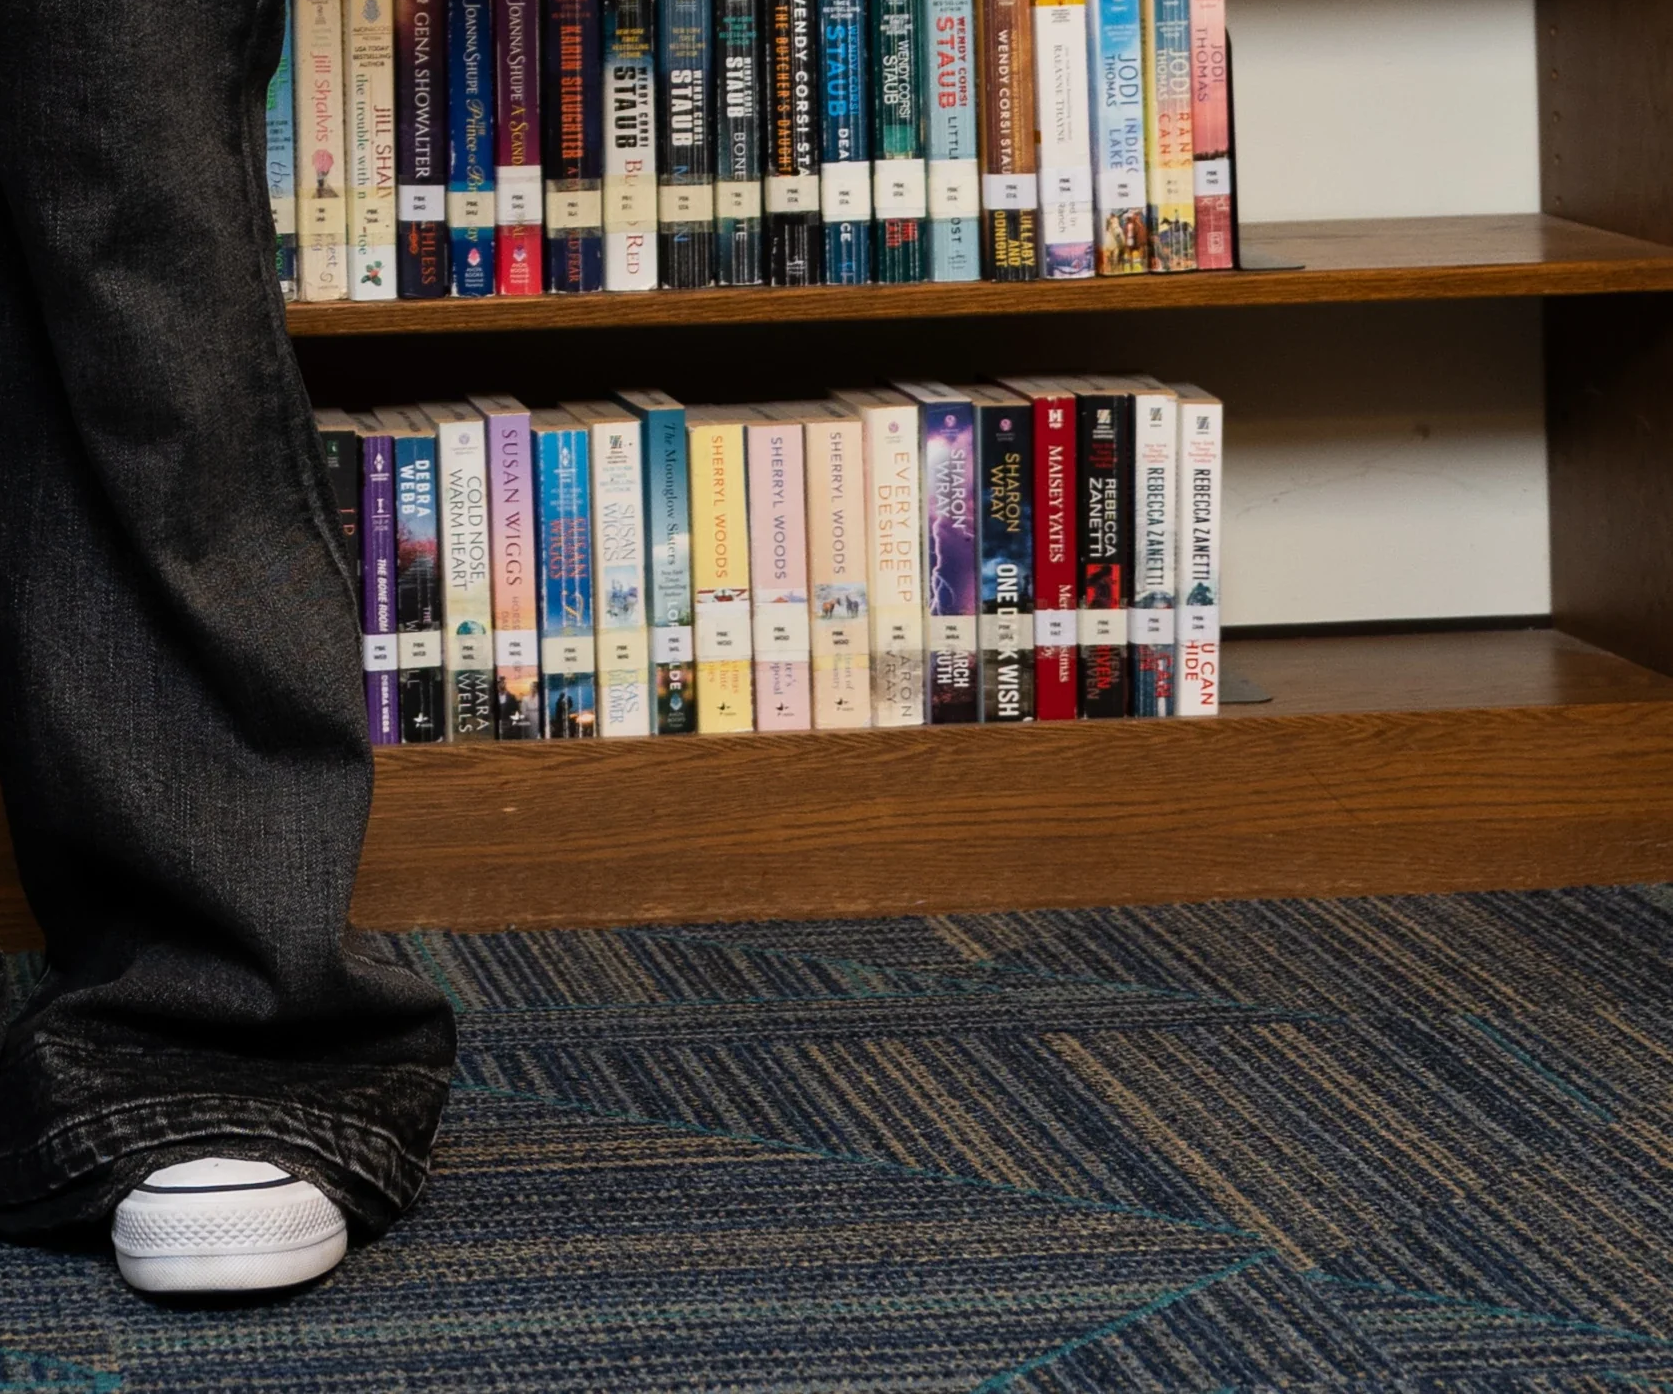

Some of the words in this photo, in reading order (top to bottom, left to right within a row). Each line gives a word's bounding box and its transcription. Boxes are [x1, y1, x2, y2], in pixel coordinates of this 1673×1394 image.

[414, 12, 429, 65] GENA
[561, 25, 582, 70] KARIN
[1105, 55, 1116, 107] THOMAS
[1119, 53, 1139, 106] JODI
[415, 69, 430, 177] SHOWALTER
[561, 77, 582, 159] SLAUGHTER
[614, 66, 636, 149] STAUB
[711, 436, 724, 507] SHERRYL
[1049, 446, 1063, 508] MAISEY
[1193, 469, 1211, 524] REBECCA
[449, 469, 462, 528] WARM
[467, 476, 483, 527] COLD
[452, 532, 466, 591] HEART
[469, 531, 485, 583] NOSE,
[714, 514, 727, 579] WOODS
[1050, 512, 1063, 562] YATES
[1193, 528, 1211, 580] ZANETTI
[997, 564, 1017, 602] ONE
[998, 664, 1018, 716] WISH
